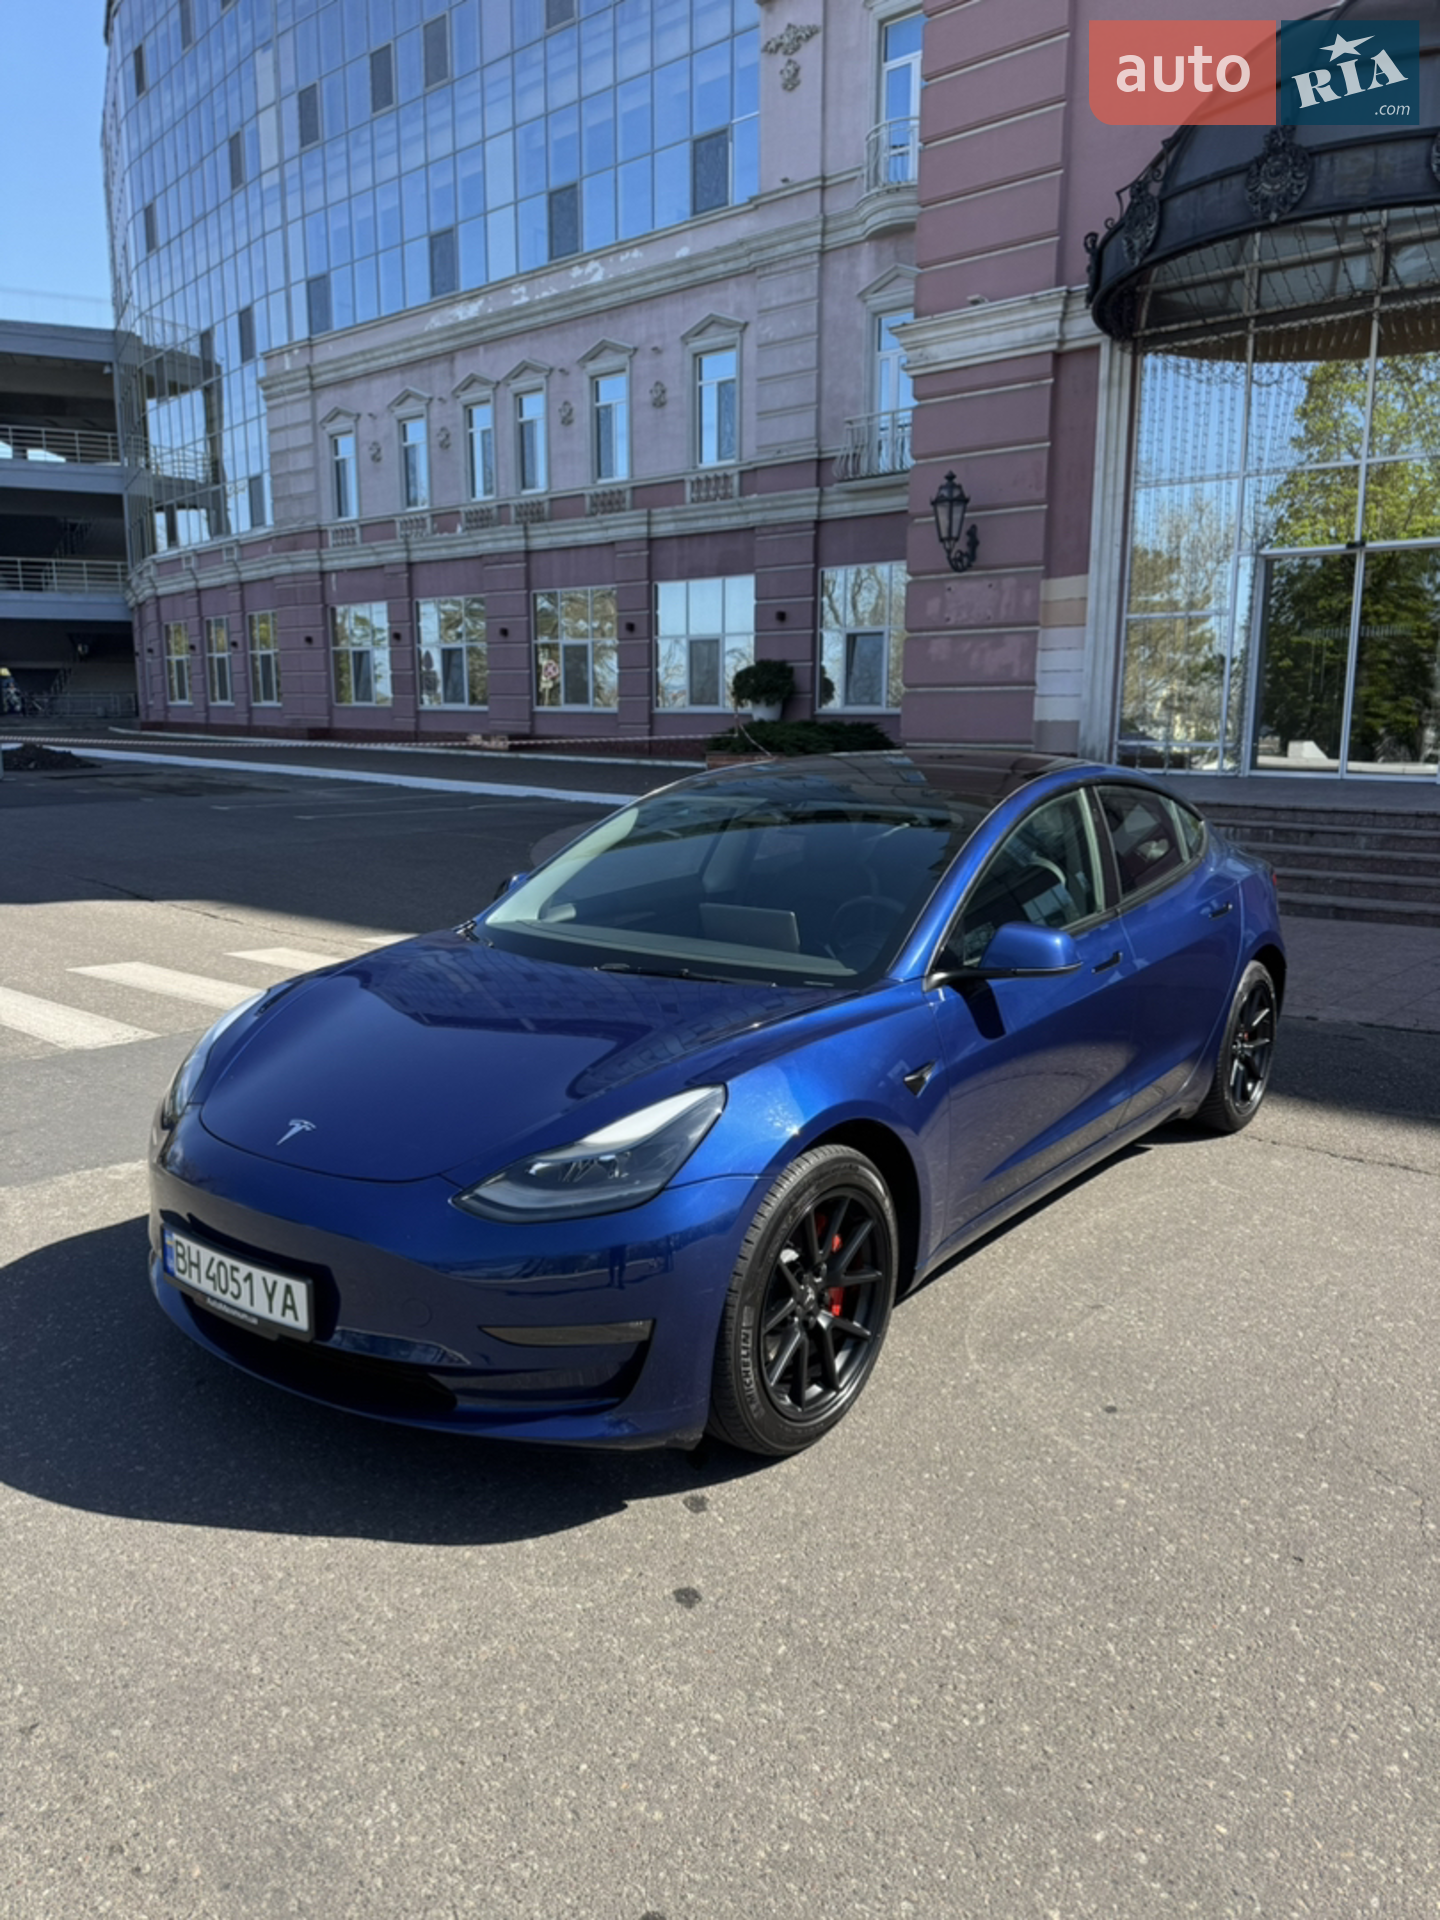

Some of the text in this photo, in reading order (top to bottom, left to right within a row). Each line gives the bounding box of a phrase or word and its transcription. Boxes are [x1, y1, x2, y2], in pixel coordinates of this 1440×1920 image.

[175, 1240, 201, 1284] BH
[205, 1256, 254, 1307] 4051
[262, 1276, 299, 1322] YA
[741, 1329, 758, 1404] MICHELIN
